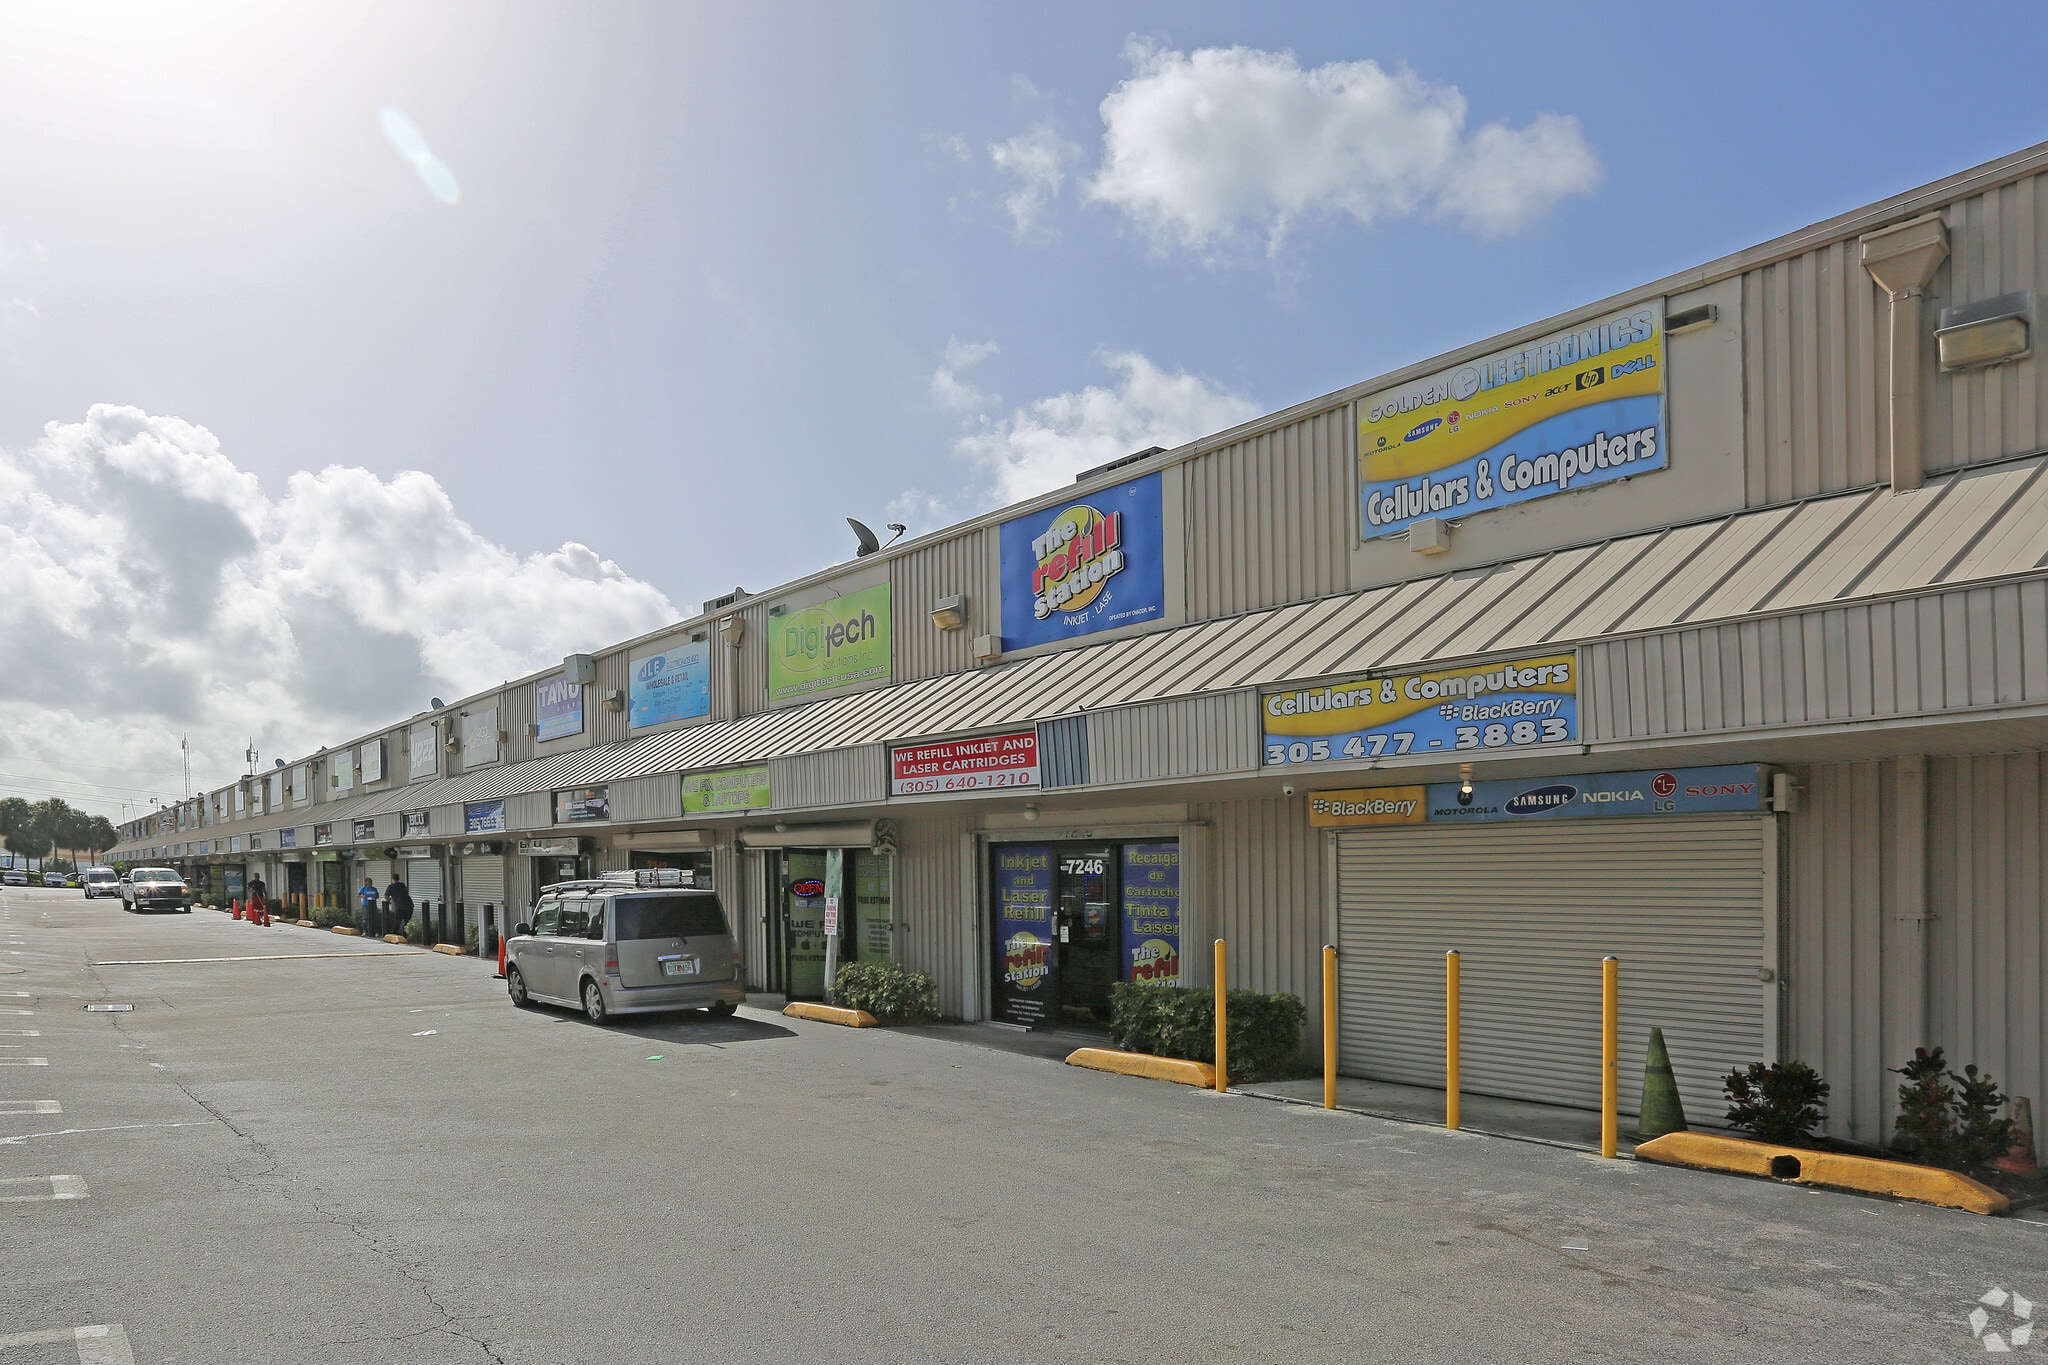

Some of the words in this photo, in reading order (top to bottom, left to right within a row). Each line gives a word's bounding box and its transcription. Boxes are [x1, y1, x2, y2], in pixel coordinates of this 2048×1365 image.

[1611, 354, 1656, 379] DELL
[1544, 382, 1572, 397] acer
[1367, 382, 1449, 423] GOLDEN
[1504, 393, 1540, 409] SONY
[1466, 405, 1500, 420] NOKIA
[1407, 421, 1440, 438] SAMSUNG
[1364, 443, 1401, 457] MOTOROLA
[1367, 476, 1470, 526] Cellulars
[1476, 459, 1494, 501] &
[1500, 427, 1657, 490] Computers
[1032, 520, 1078, 561] The
[1032, 511, 1121, 597] refill
[1063, 611, 1090, 626] INKJET
[785, 608, 875, 660] Digitech
[641, 660, 660, 678] JLE
[1267, 688, 1373, 717] Cellulars
[1379, 678, 1398, 704] &
[1404, 663, 1570, 700] Computers
[1461, 698, 1563, 723] BlackBerry
[895, 752, 914, 762] WE
[917, 747, 953, 761] REFILL
[956, 741, 999, 756] INKJET
[1002, 737, 1035, 751] AND
[1266, 740, 1331, 766] 305
[1342, 731, 1416, 760] 477
[1455, 718, 1569, 750] 3883
[902, 763, 939, 775] LASER
[942, 753, 1026, 771] CARTRIDGES
[685, 780, 699, 793] WE
[700, 778, 714, 793] FIX
[716, 771, 768, 791] COMPUTERS
[900, 779, 939, 793] (305)
[945, 772, 1030, 790] 640-1210
[1685, 783, 1755, 797] SONY
[703, 794, 710, 807] &
[711, 790, 750, 806] LAPTOPS
[1513, 793, 1569, 807] SAMSUNG
[1583, 790, 1645, 803] NOKIA
[1331, 799, 1417, 817] BlackBerry
[1434, 806, 1499, 816] MOTOROLA
[1654, 800, 1675, 812] LG
[1001, 854, 1048, 872] Inkjet
[1066, 859, 1104, 875] 7246
[1013, 876, 1035, 887] and
[1148, 870, 1165, 881] de
[793, 883, 825, 894] OPEN
[1002, 888, 1047, 904] Laser
[1003, 905, 1047, 921] Refill
[1124, 903, 1169, 918] Tinta
[791, 920, 815, 929] WE
[1005, 937, 1028, 951] The
[1132, 945, 1160, 961] The
